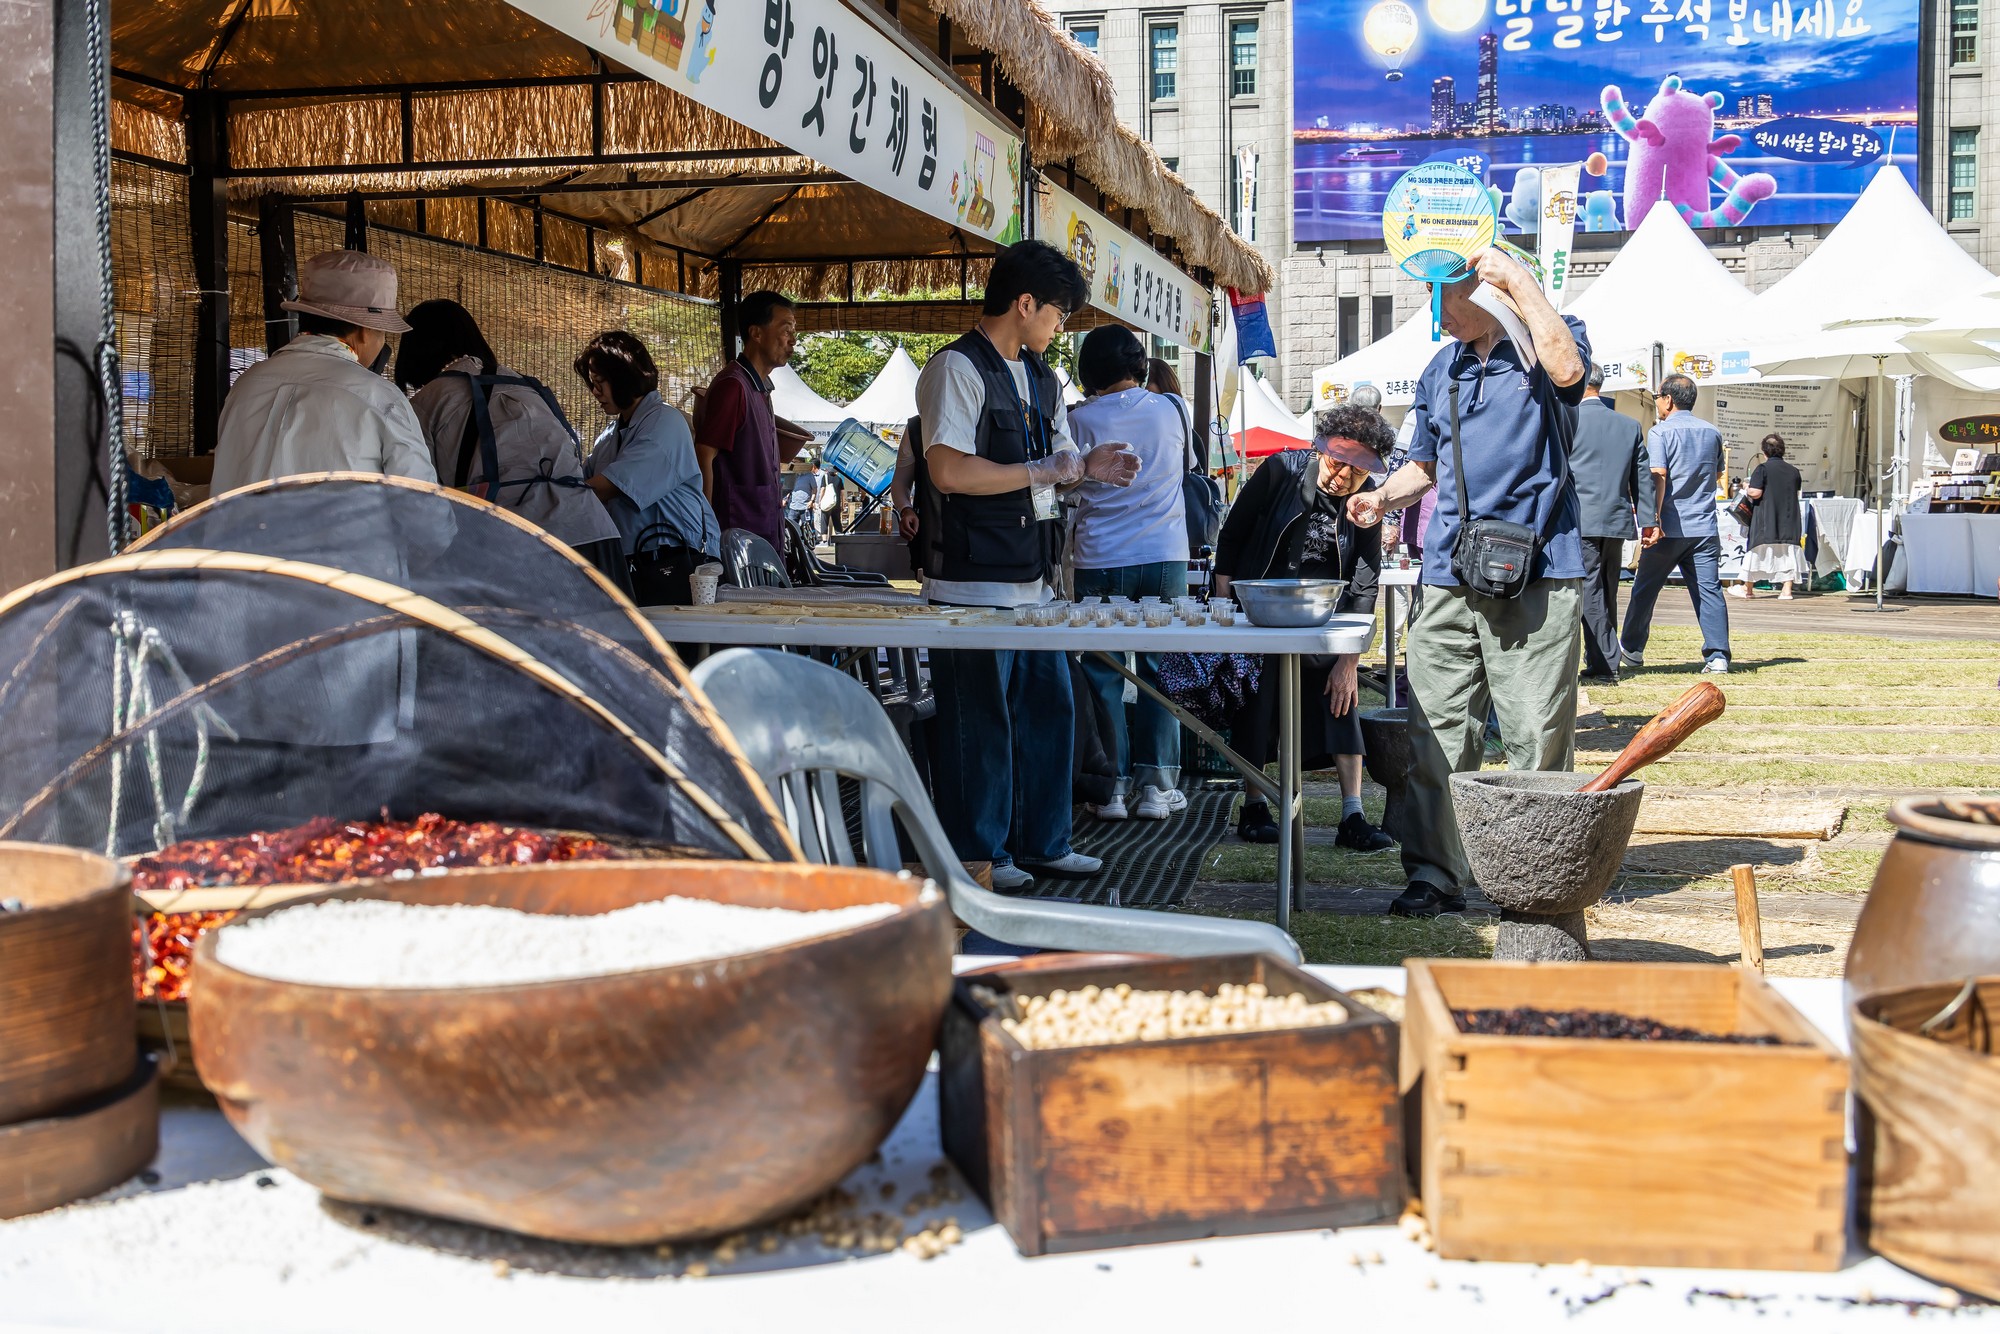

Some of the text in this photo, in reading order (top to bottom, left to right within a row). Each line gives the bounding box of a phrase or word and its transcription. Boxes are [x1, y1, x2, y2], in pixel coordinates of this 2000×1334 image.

[1641, 0, 1712, 43] 추석
[1726, 0, 1872, 46] 보내세요
[758, 0, 938, 191] 방앗간체험
[1755, 131, 1881, 157] 역시 서울은 달라 달라
[1432, 218, 1445, 226] ONE
[1133, 261, 1183, 333] 방앗간체험
[1980, 423, 2000, 437] 생강
